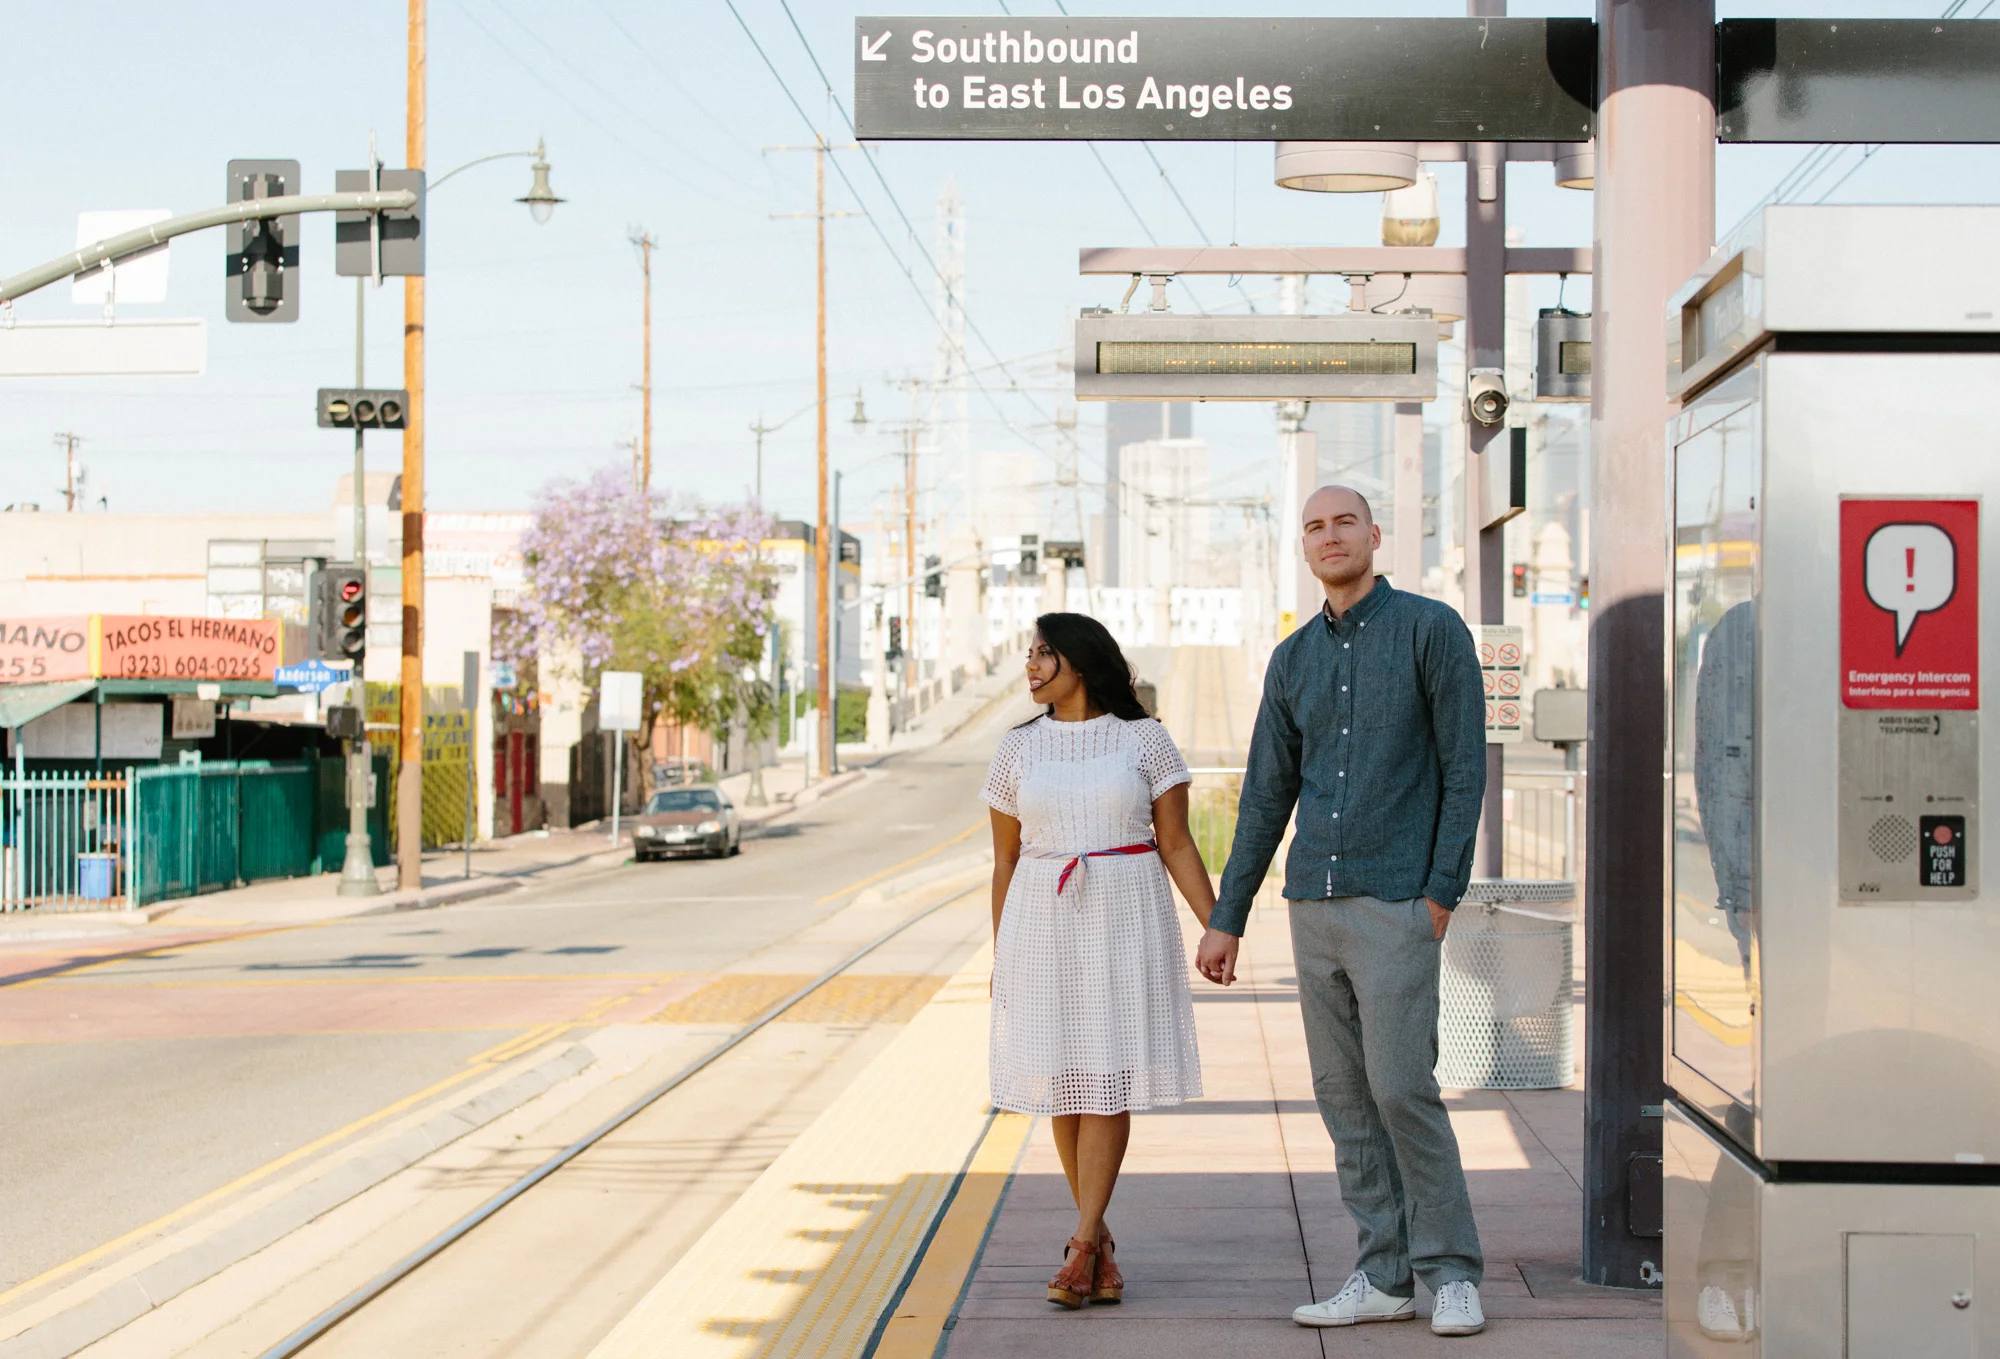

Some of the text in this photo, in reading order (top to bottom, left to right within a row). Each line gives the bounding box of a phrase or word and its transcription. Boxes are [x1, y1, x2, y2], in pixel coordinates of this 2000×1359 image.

[911, 30, 1139, 64] Southbound
[914, 76, 1293, 118] to East Los Angeles
[105, 618, 277, 655] TACOS EL HERMANO
[120, 654, 262, 677] (323) 604-0255
[278, 669, 331, 682] Anderson
[1849, 671, 1971, 685] Emergency Intercom
[1848, 686, 1970, 698] Interfono para emergencia
[1879, 716, 1931, 725] ASSISTANCE
[1880, 726, 1928, 735] TELEPHONE
[1930, 845, 1956, 859] PUSH
[1932, 858, 1953, 871] FOR
[1930, 871, 1956, 885] HELP
